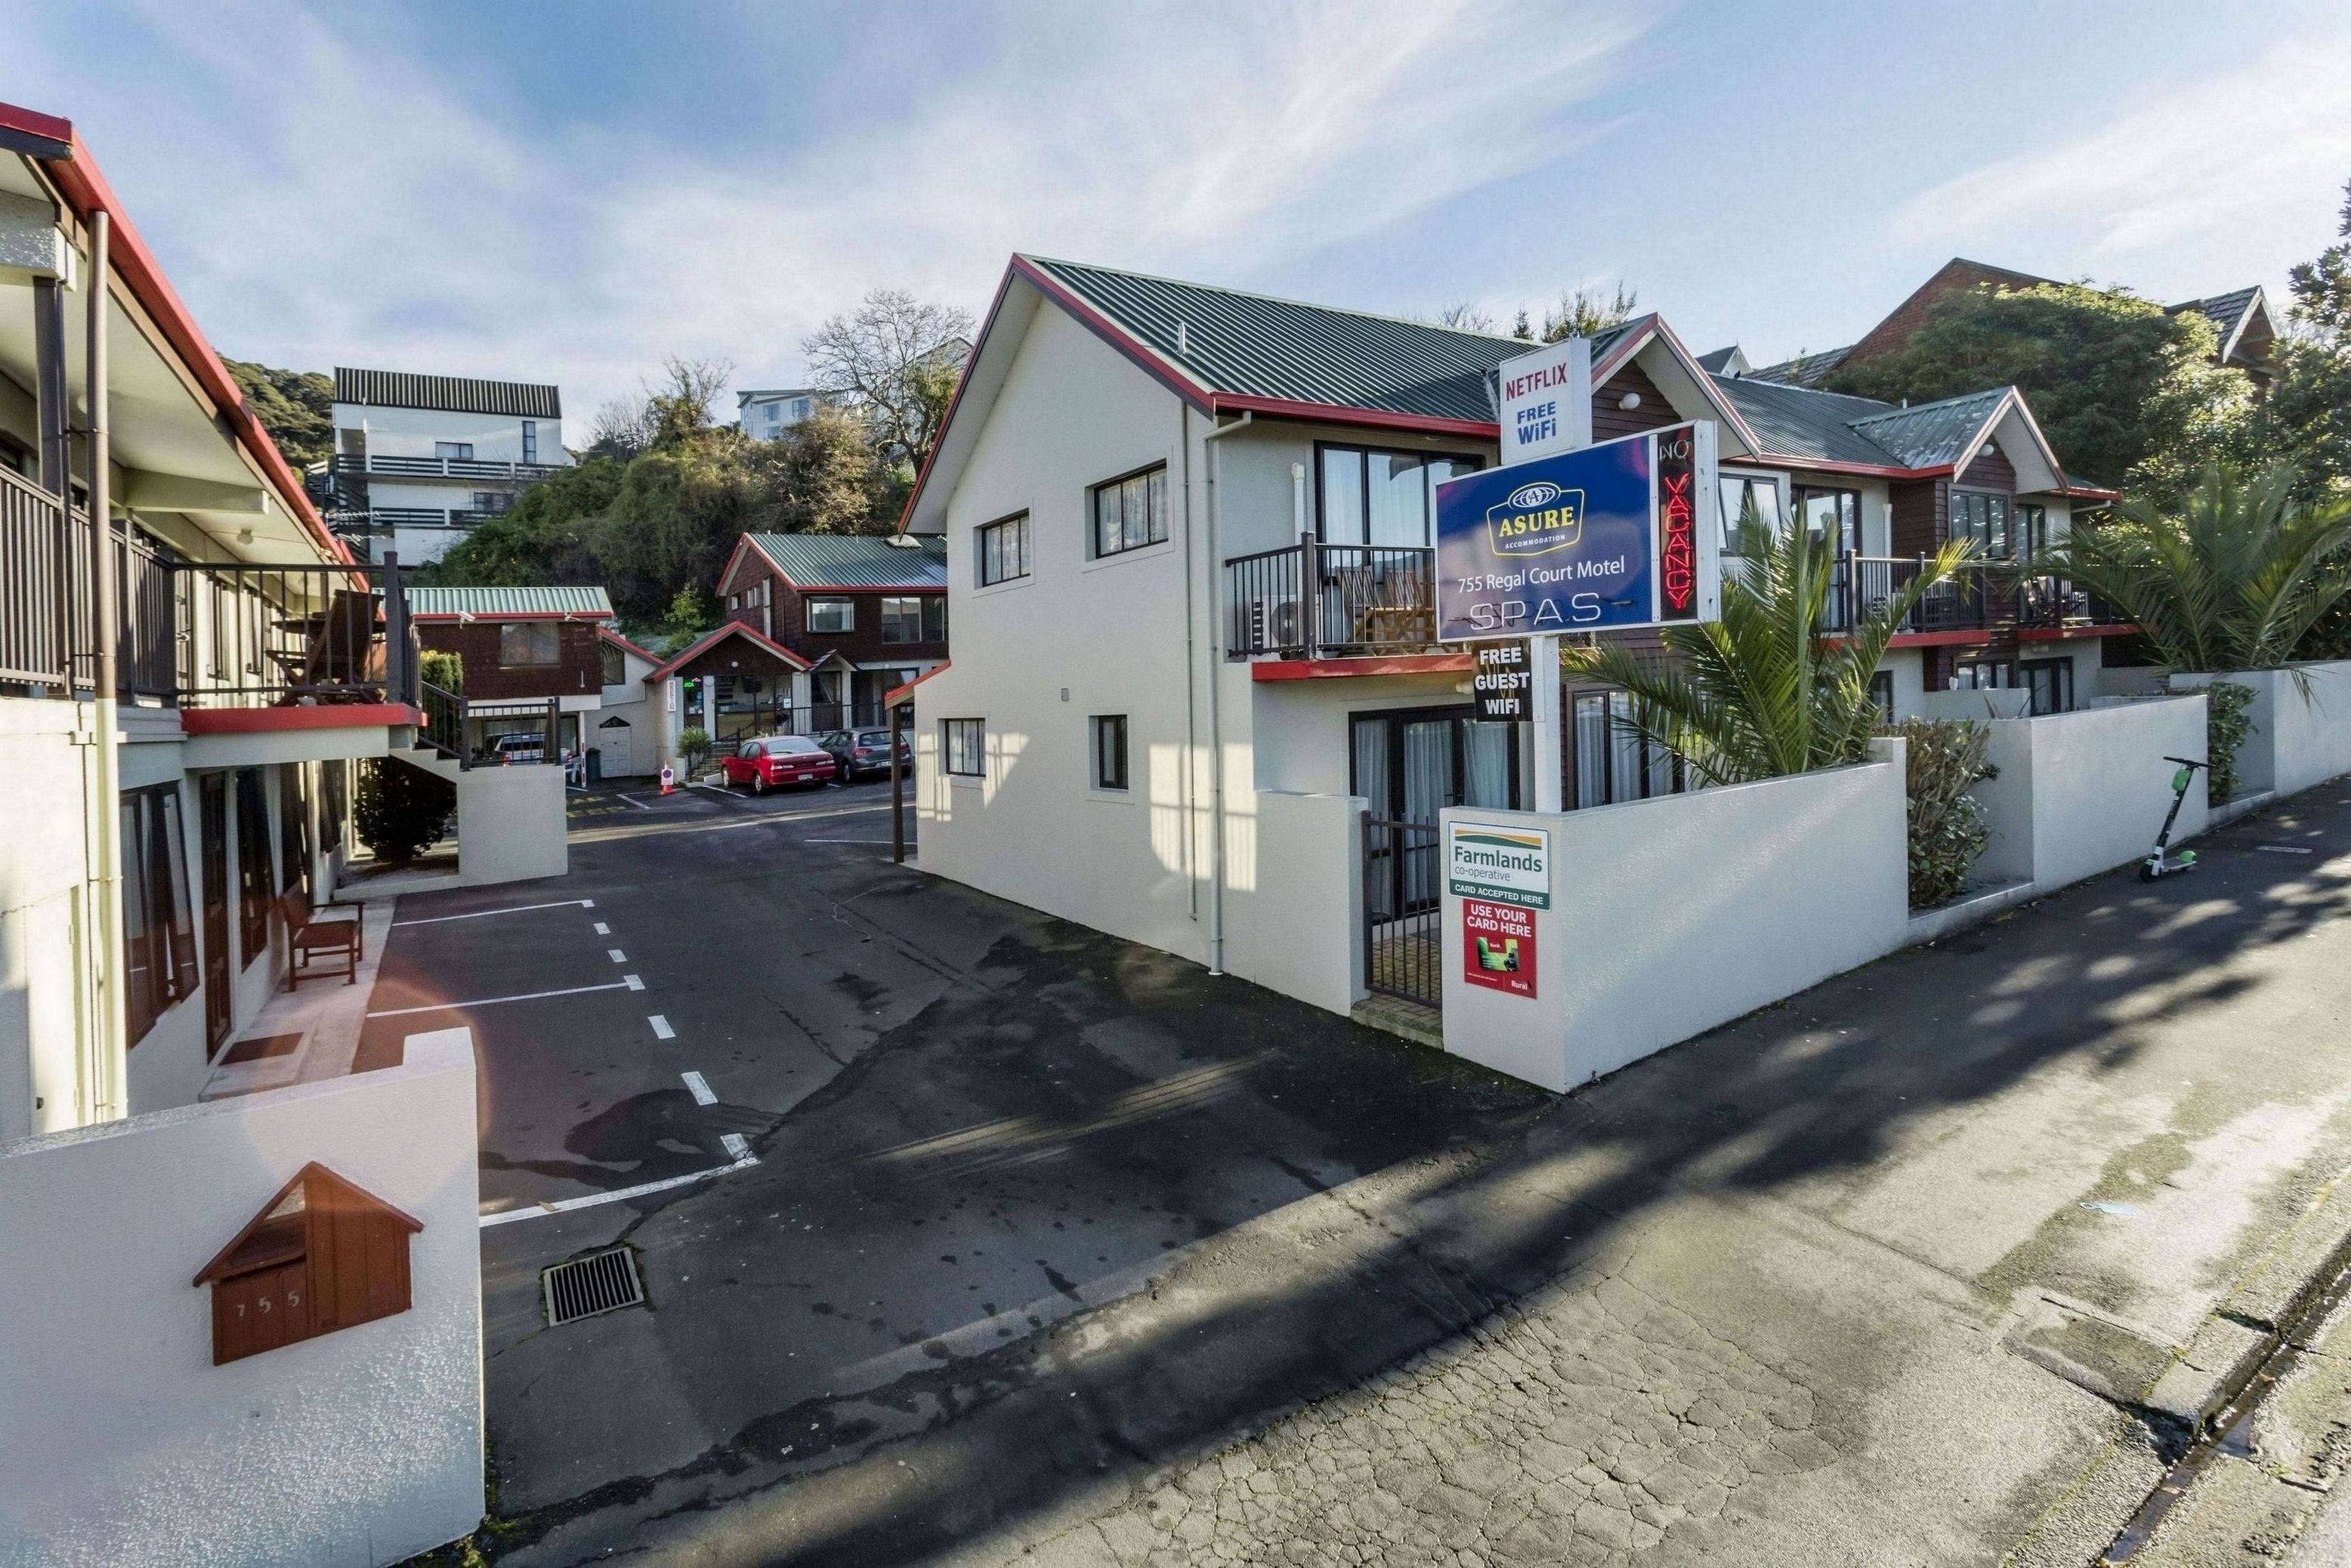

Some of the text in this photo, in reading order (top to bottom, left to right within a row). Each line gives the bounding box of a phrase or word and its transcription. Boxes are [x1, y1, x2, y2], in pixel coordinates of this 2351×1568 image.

[1506, 363, 1567, 402] NETFLIX
[1517, 401, 1556, 424] FREE
[1518, 418, 1556, 445] WiFi
[1659, 440, 1690, 461] NO
[1499, 506, 1575, 538] ASURE
[1505, 534, 1566, 550] ACCOMMODATION
[1664, 473, 1691, 609] VACANCY
[1458, 555, 1625, 593] 755 Regal Court Motel
[1470, 592, 1601, 630] SPAS
[1479, 647, 1522, 665] FREE
[1475, 671, 1530, 690] GUEST
[1484, 698, 1520, 715] WIFI
[1455, 846, 1543, 872] Farmlands
[1455, 866, 1511, 882] co-operative
[1455, 884, 1544, 905] CARD ACCEPTED HERE
[1470, 903, 1527, 924] USE YOUR
[1466, 915, 1532, 937] CARD HERE
[1511, 980, 1528, 990] Rural
[236, 1289, 300, 1317] 755
